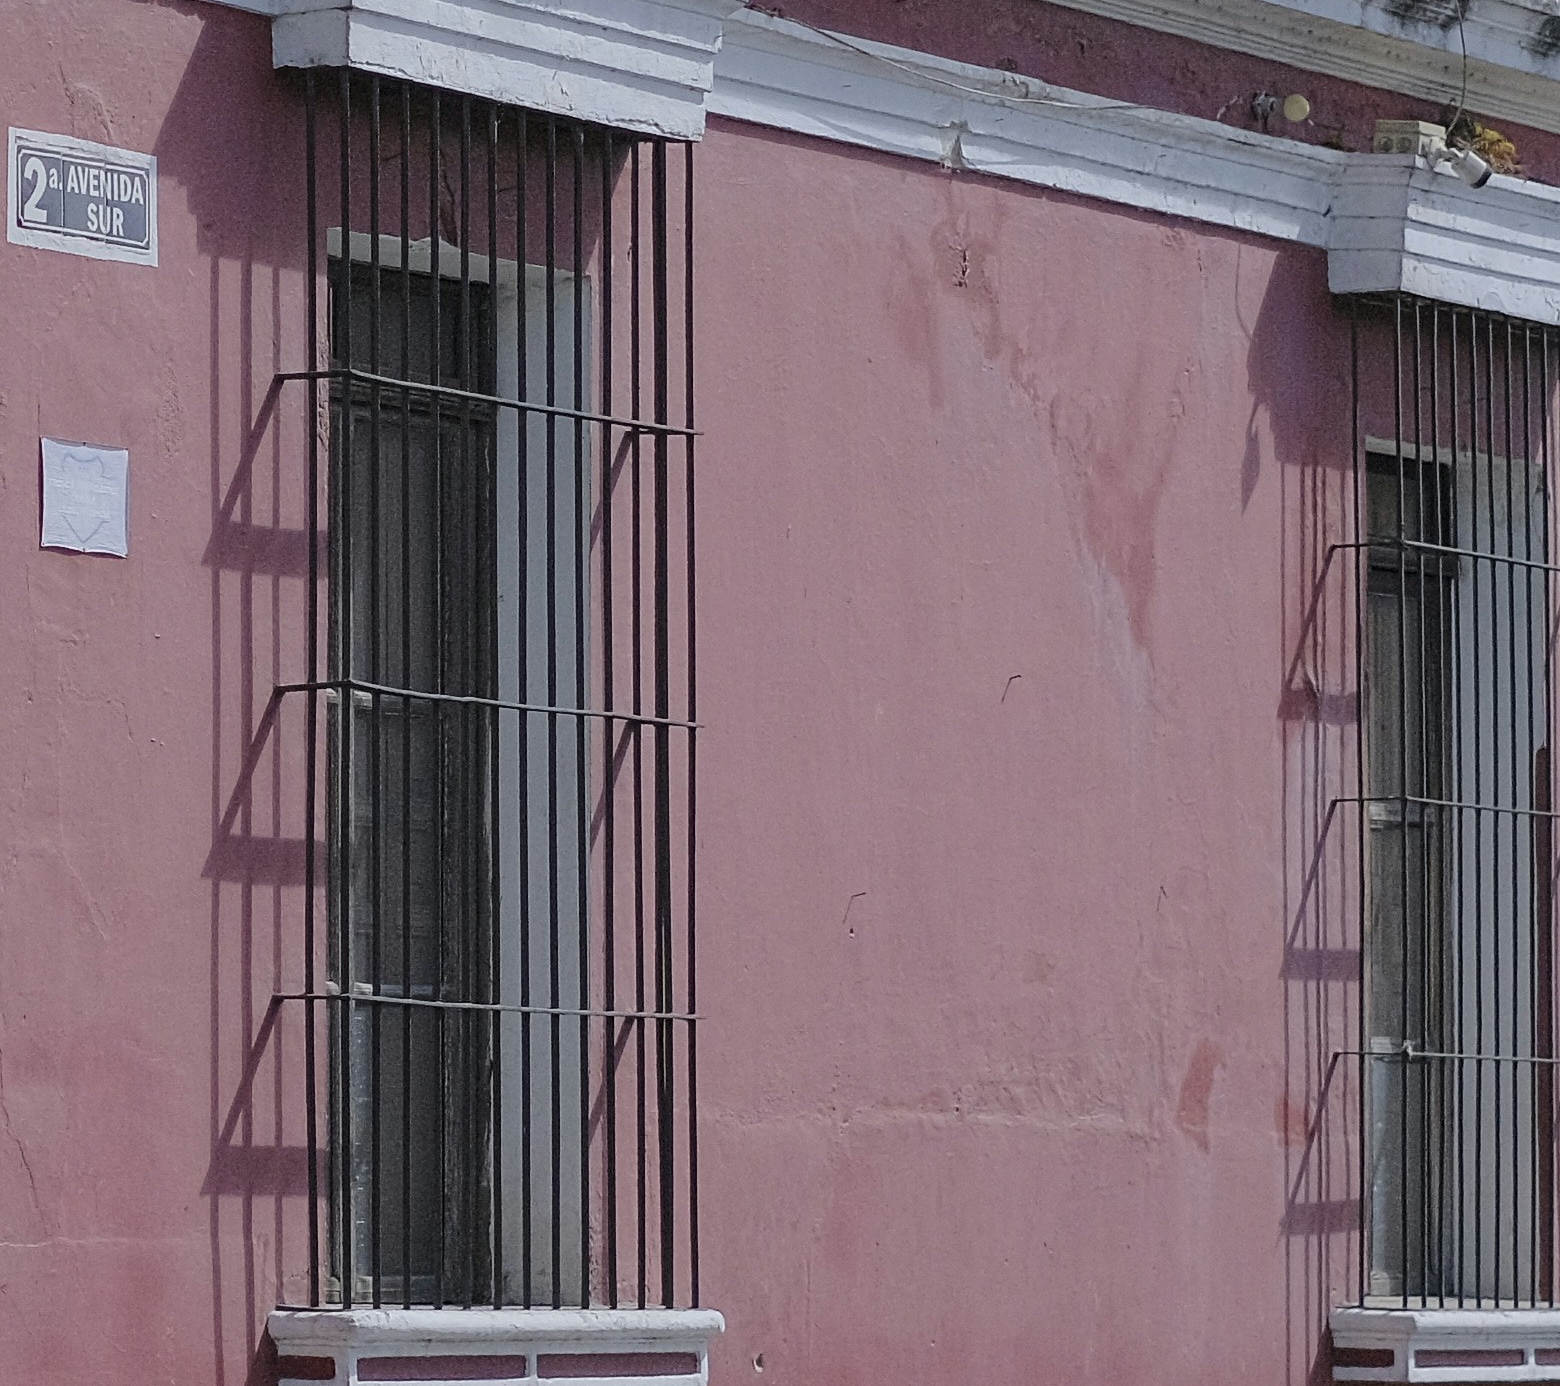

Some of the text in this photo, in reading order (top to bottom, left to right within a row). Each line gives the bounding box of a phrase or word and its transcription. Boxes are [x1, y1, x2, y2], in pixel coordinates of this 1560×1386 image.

[23, 156, 144, 223] 2a. AVENIDA
[87, 203, 124, 237] SUR
